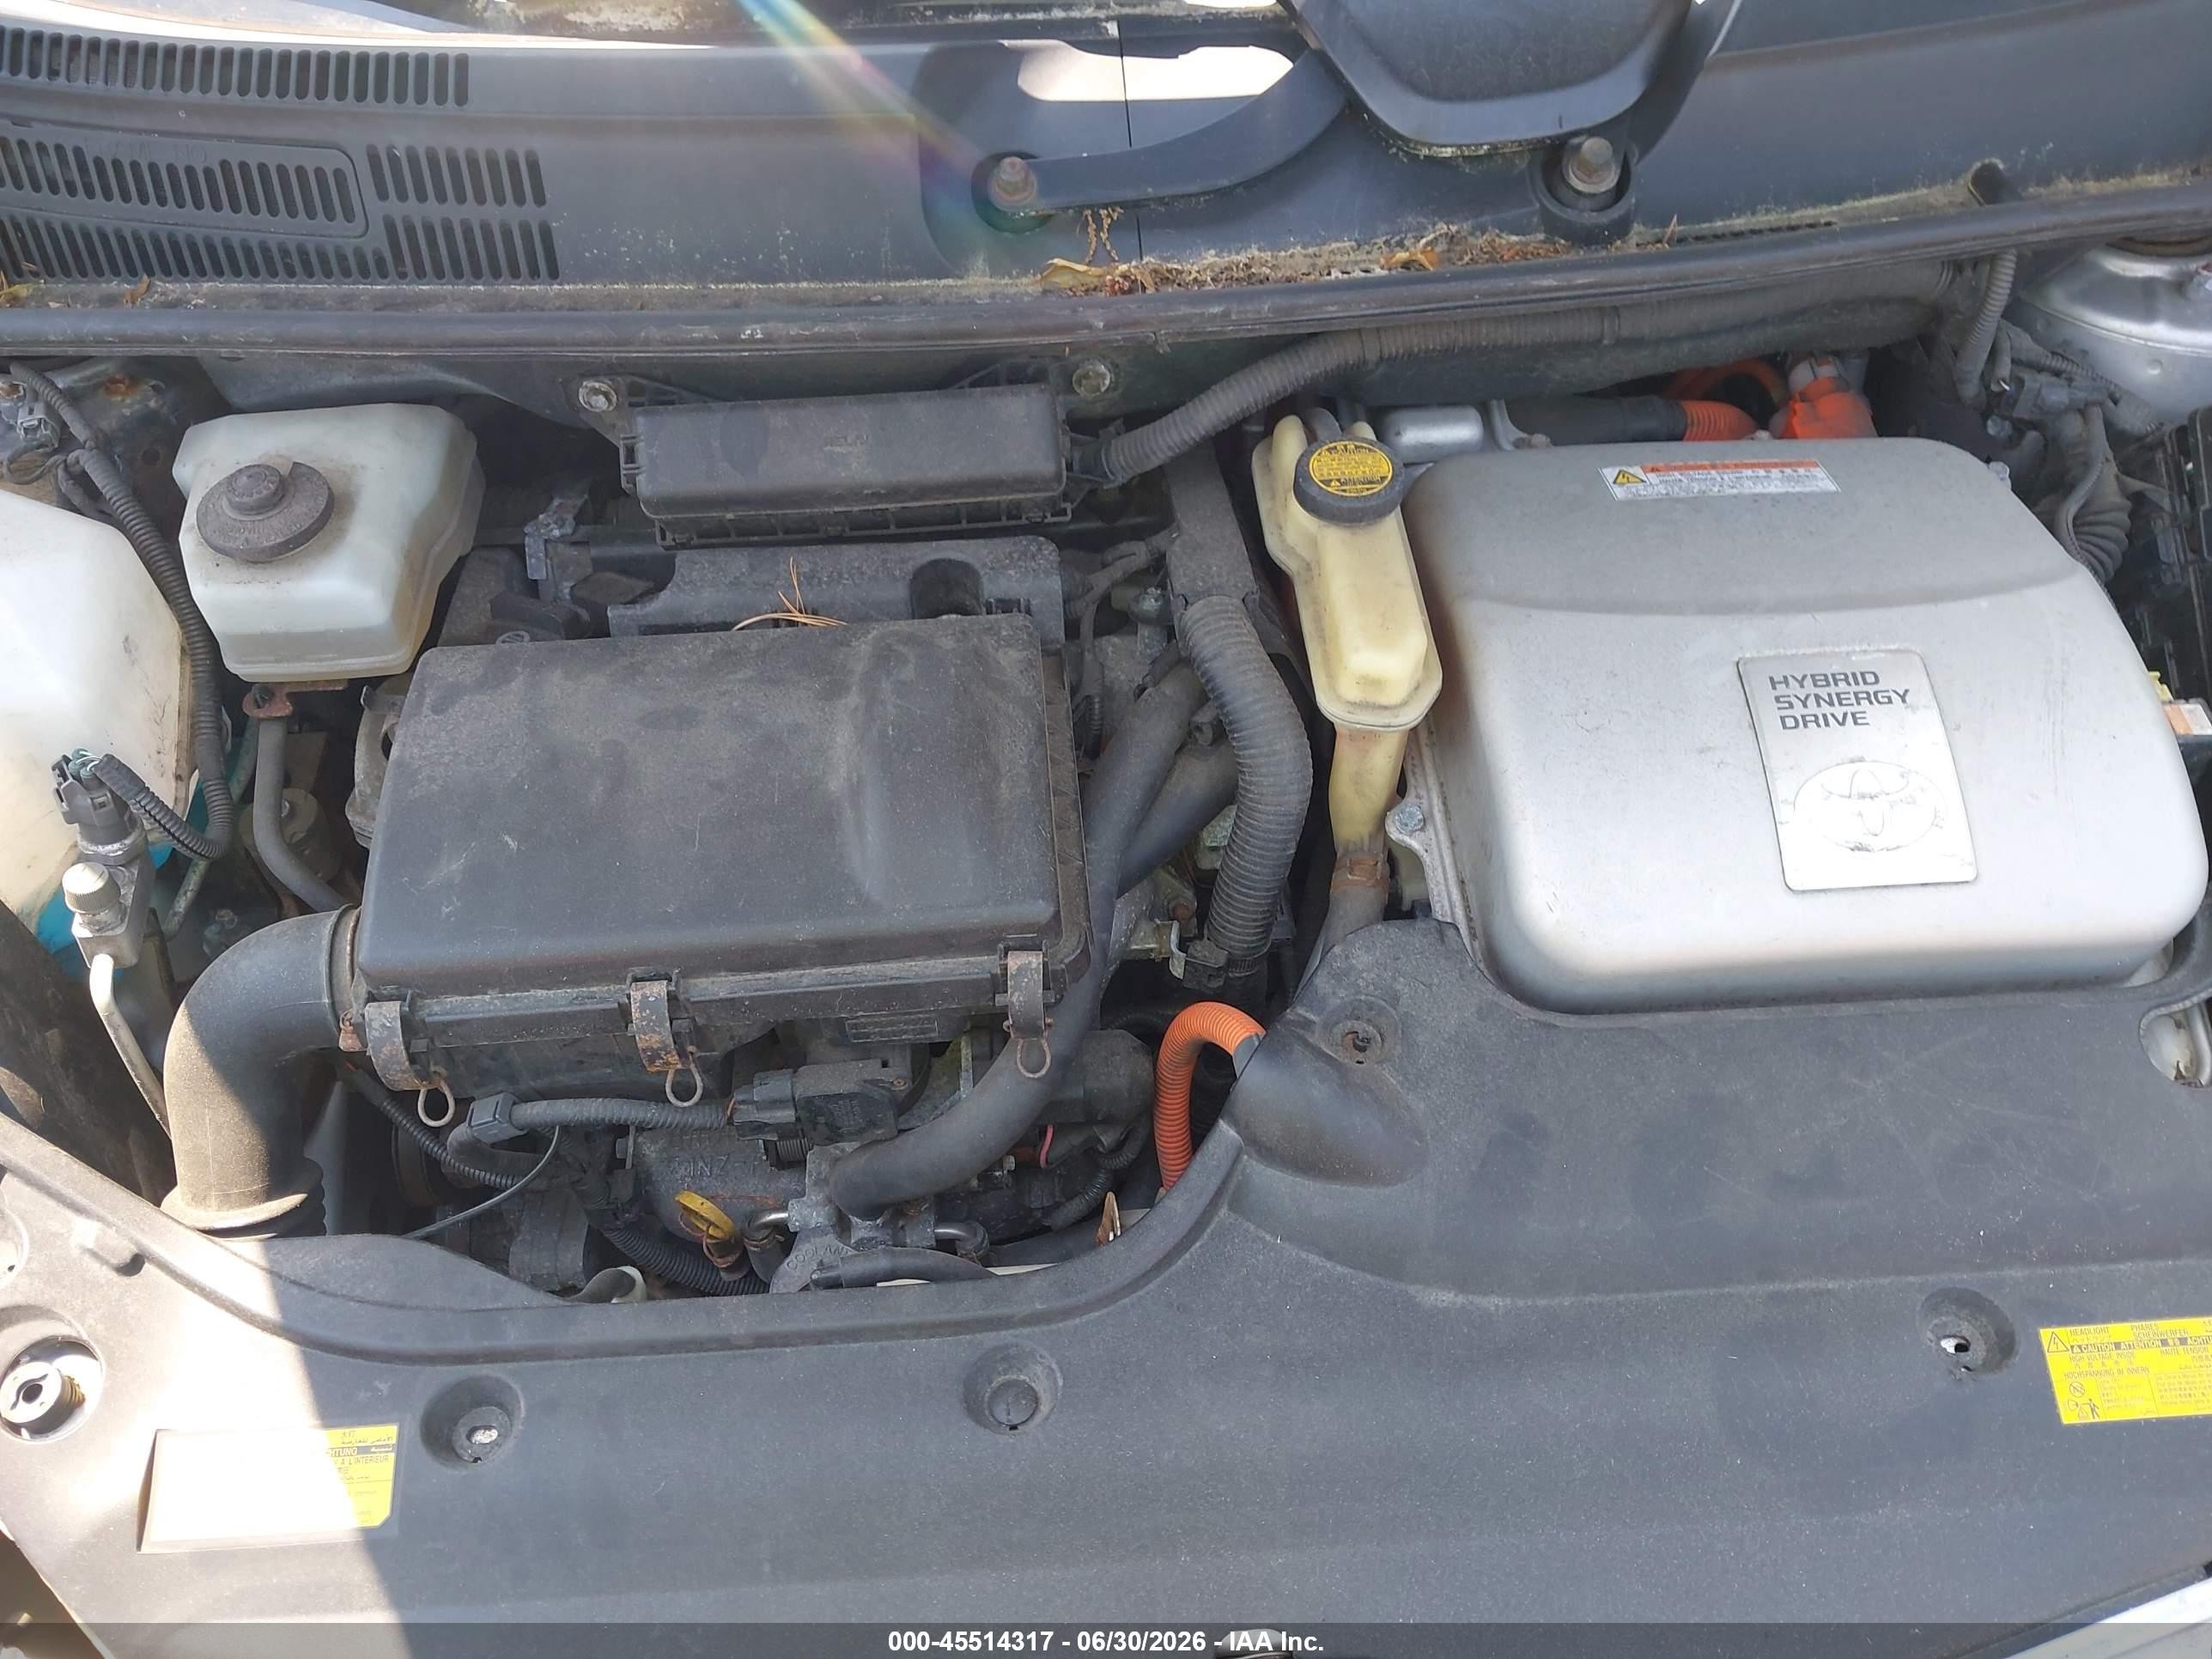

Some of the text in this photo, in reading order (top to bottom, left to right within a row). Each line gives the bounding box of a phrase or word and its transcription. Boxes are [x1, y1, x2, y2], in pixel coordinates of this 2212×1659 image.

[1769, 671, 1880, 690] HYBRID
[1774, 689, 1910, 710] SYNERGY
[1779, 711, 1870, 730] DRIVE
[2069, 1326, 2110, 1336] HEADLIGHT
[2081, 1342, 2115, 1352] CAUTION
[2121, 1339, 2161, 1350] ATTENTION
[2184, 1346, 2208, 1354] TENSION
[2069, 1354, 2084, 1363] HIGH
[2087, 1352, 2113, 1362] VOLTAGE
